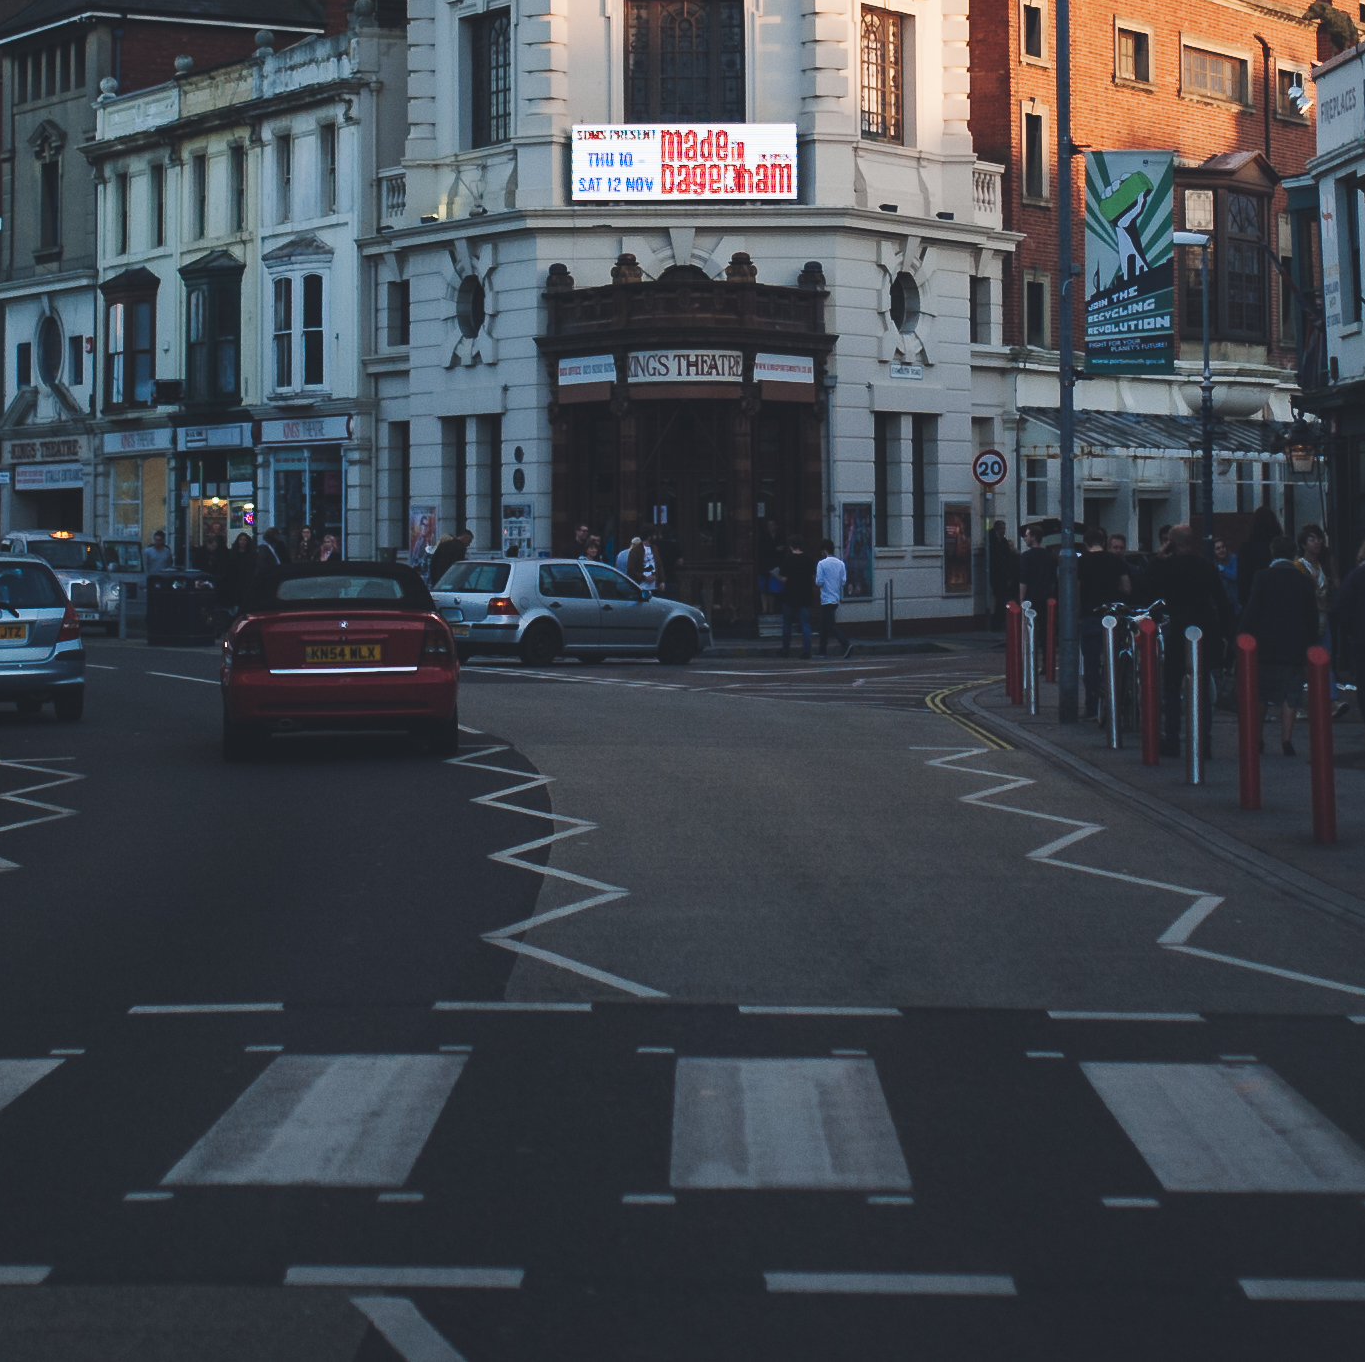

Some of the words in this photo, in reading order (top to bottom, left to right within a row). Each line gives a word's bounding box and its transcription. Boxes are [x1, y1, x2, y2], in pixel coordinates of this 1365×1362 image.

[1320, 87, 1357, 125] FIREPLACES
[588, 152, 615, 167] THU
[619, 152, 634, 167] 10
[578, 177, 603, 192] SAT
[607, 177, 622, 192] 12
[626, 177, 654, 192] NOV
[1088, 298, 1108, 311] JOIN
[1111, 285, 1138, 303] THE
[1087, 298, 1155, 323] RECYCLING
[1087, 315, 1170, 335] REVOLUTION
[1089, 341, 1107, 349] FIGHT
[1109, 339, 1121, 347] FOR
[673, 354, 742, 377] THEATRE
[978, 460, 1003, 477] 20
[1, 626, 22, 638] JTZ
[310, 646, 346, 661] KN54
[349, 646, 376, 660] WLX
